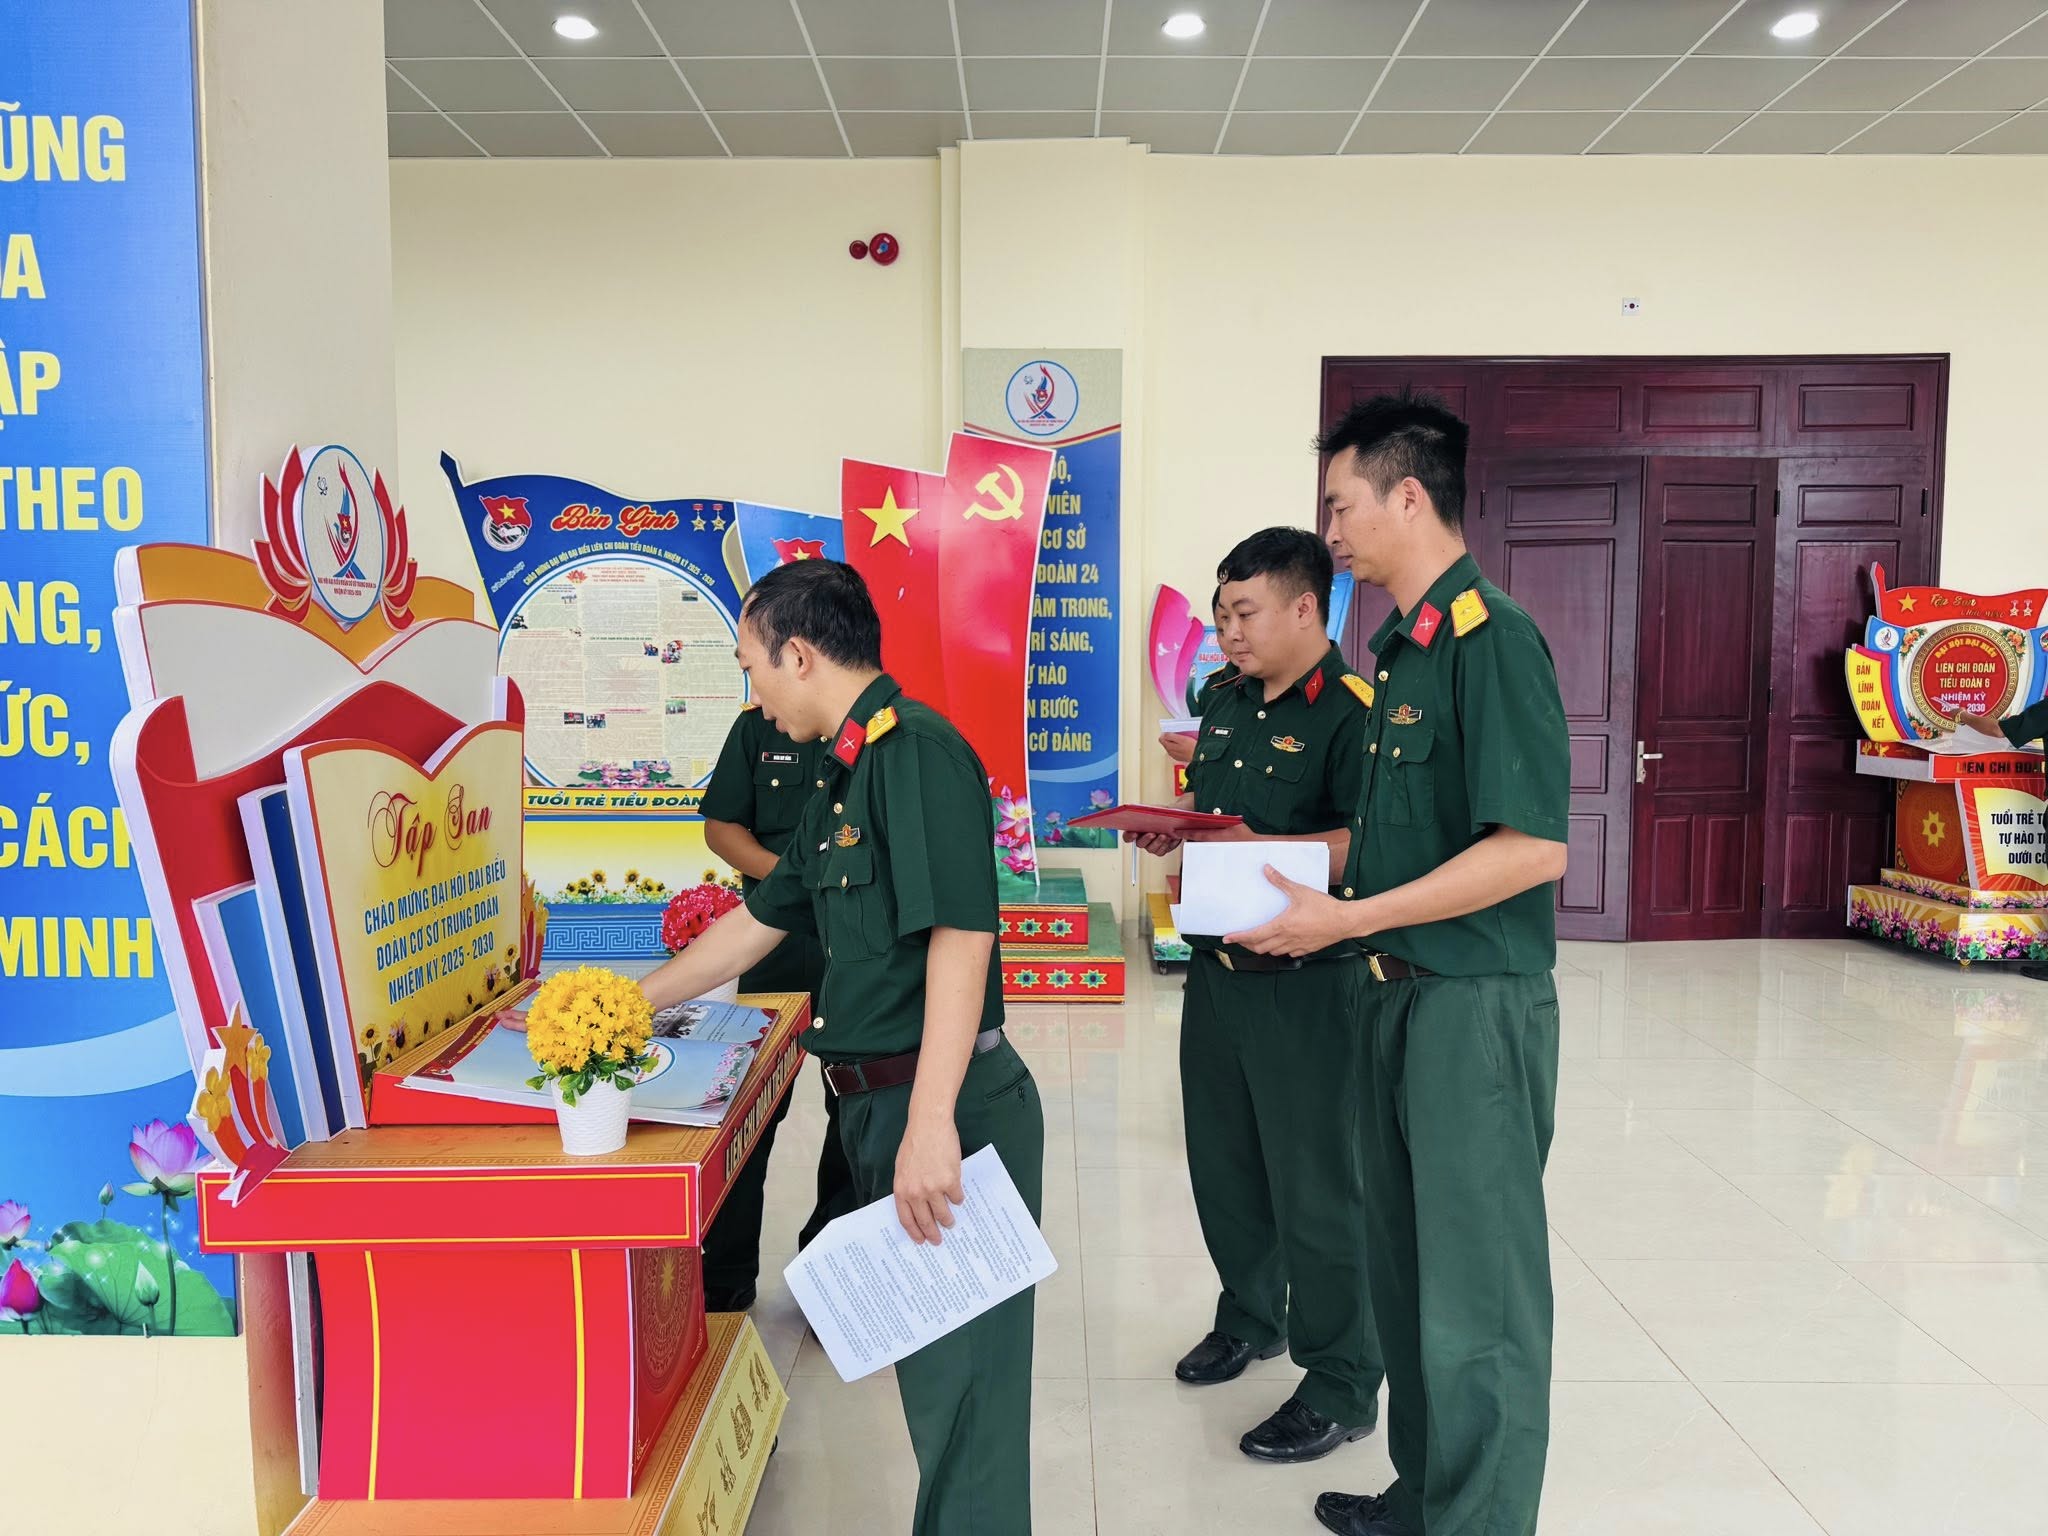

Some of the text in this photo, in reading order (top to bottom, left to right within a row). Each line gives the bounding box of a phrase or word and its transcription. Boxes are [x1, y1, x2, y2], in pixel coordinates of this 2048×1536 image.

[1047, 490, 1081, 515] VIÊN
[550, 503, 679, 538] Bản Lĩnh
[1042, 522, 1086, 550] CƠ SỞ
[1037, 560, 1099, 584] ĐOÀN 24
[1060, 598, 1112, 620] TRONG,
[1049, 627, 1094, 654] SÁNG,
[1038, 661, 1067, 685] HÀO
[1856, 661, 1871, 675] BẢN
[1956, 662, 1970, 673] CHI
[1858, 680, 1874, 693] LĨNH
[1940, 674, 1957, 688] TIỂU
[1984, 678, 1990, 688] 6
[1040, 695, 1079, 719] BƯỚC
[1941, 691, 1986, 704] NHIỆM KỲ
[1966, 703, 1986, 713] 2030
[1872, 715, 1885, 729] KẾT
[1028, 726, 1092, 752] CỜ ĐẢNG
[1989, 761, 2010, 774] CHI
[527, 791, 703, 807] TUỔI TRẺ TIỂU ĐOÀN
[1991, 809, 2013, 825] TUỔI
[2016, 809, 2034, 825] TRẺ
[368, 784, 493, 878] Tập San
[1999, 832, 2013, 848] TỰ
[2014, 830, 2034, 845] HÀO
[2008, 850, 2032, 864] DƯỚI
[364, 852, 506, 935] CHÀO MỪNG ĐẠI HỘI ĐẠI BIỂU
[376, 894, 499, 971] ĐOÀN CƠ SỞ TRUNG ĐOÀN
[0, 917, 153, 979] MINH
[388, 966, 424, 1005] NHIỆM
[426, 953, 439, 984] KỲ
[441, 945, 464, 977] 2025
[472, 931, 494, 960] 2030
